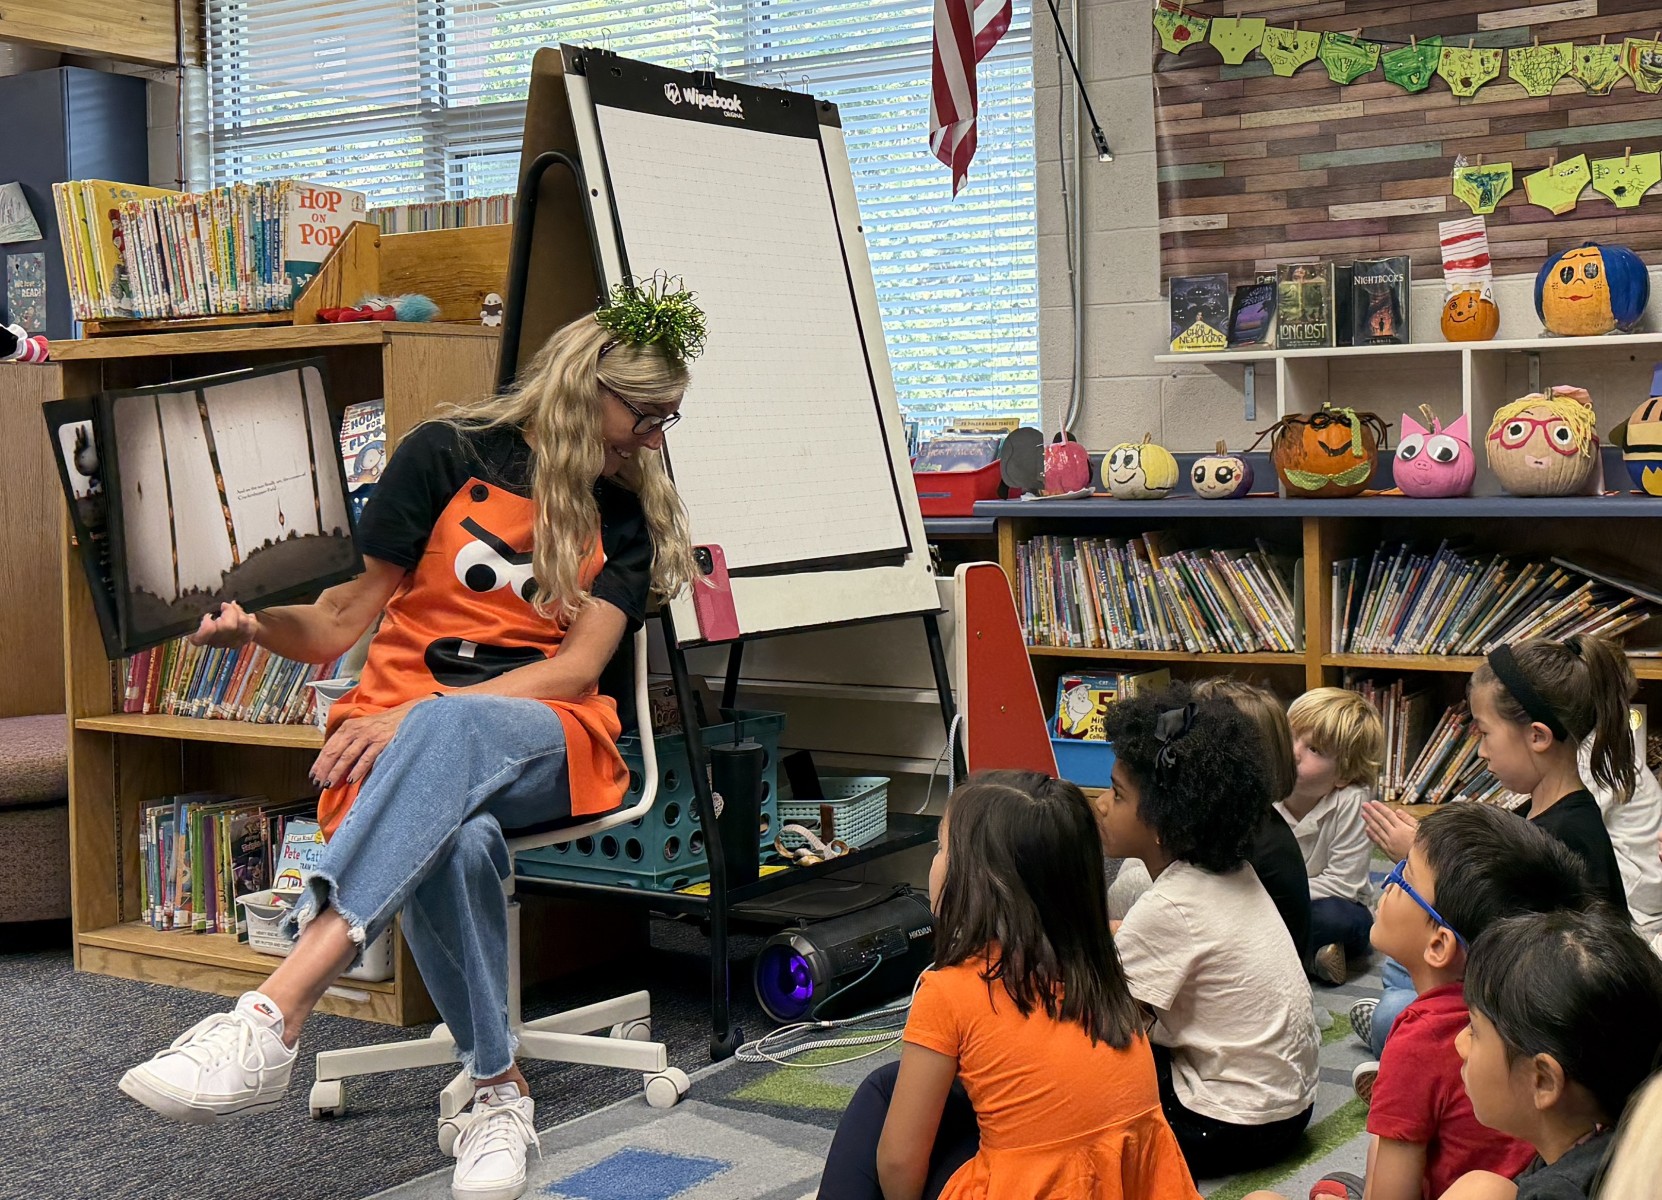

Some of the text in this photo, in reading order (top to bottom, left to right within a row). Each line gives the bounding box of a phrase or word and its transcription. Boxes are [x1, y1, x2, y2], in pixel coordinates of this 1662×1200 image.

[682, 87, 743, 112] Wipebook
[298, 188, 342, 213] HOP
[311, 213, 326, 223] ON
[298, 223, 341, 247] POP
[1353, 273, 1404, 286] NIGHTBOOKS
[1179, 334, 1224, 344] NEXT DOOR
[1280, 323, 1328, 340] LONG LOST
[366, 418, 381, 430] FOR
[350, 431, 371, 451] FLY
[1096, 692, 1114, 716] 5
[1091, 716, 1105, 724] Min
[284, 844, 301, 860] Pete
